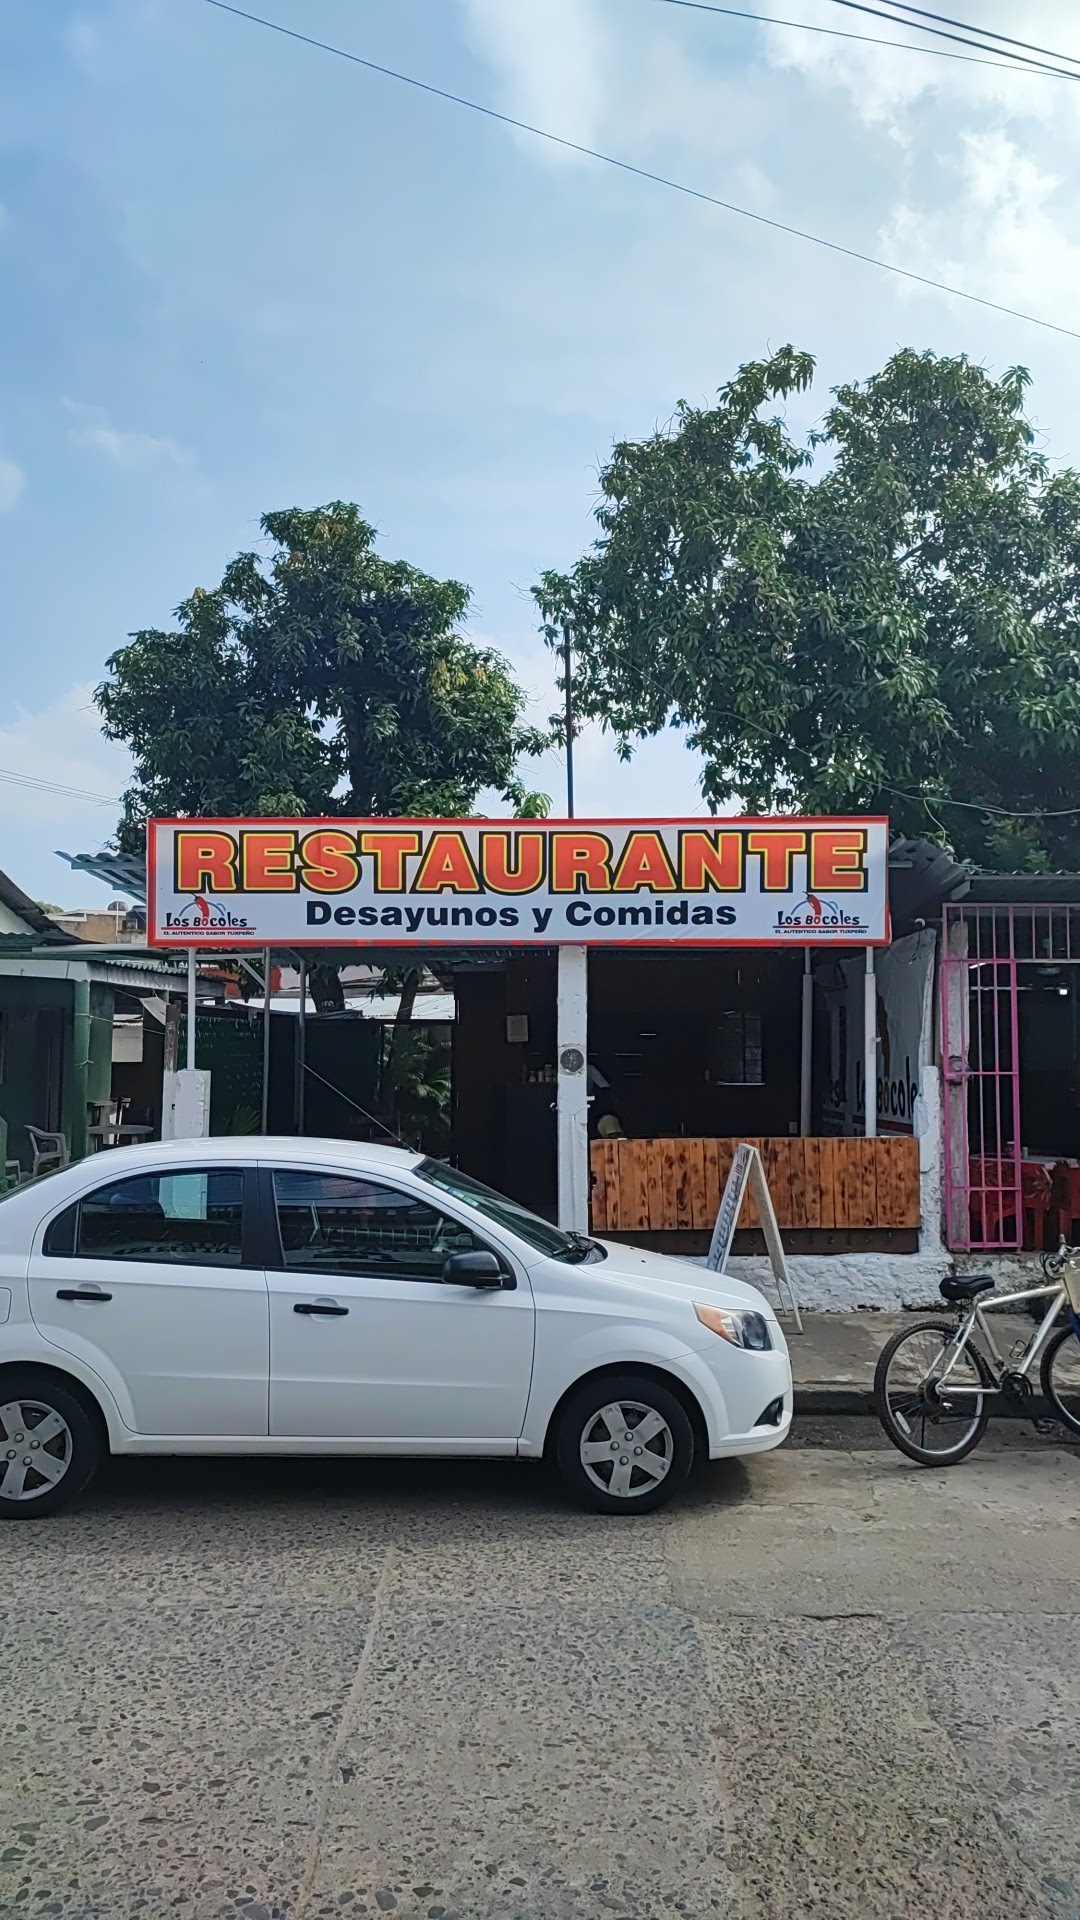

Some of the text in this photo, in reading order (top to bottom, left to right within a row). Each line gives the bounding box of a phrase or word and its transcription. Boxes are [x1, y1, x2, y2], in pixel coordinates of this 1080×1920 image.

[173, 828, 869, 895] RESTAURANTE
[166, 911, 248, 927] Los Bocoles
[306, 900, 737, 933] Desayunos y Comidas
[777, 909, 860, 926] Los Bocoles
[876, 1055, 918, 1120] Bocole
